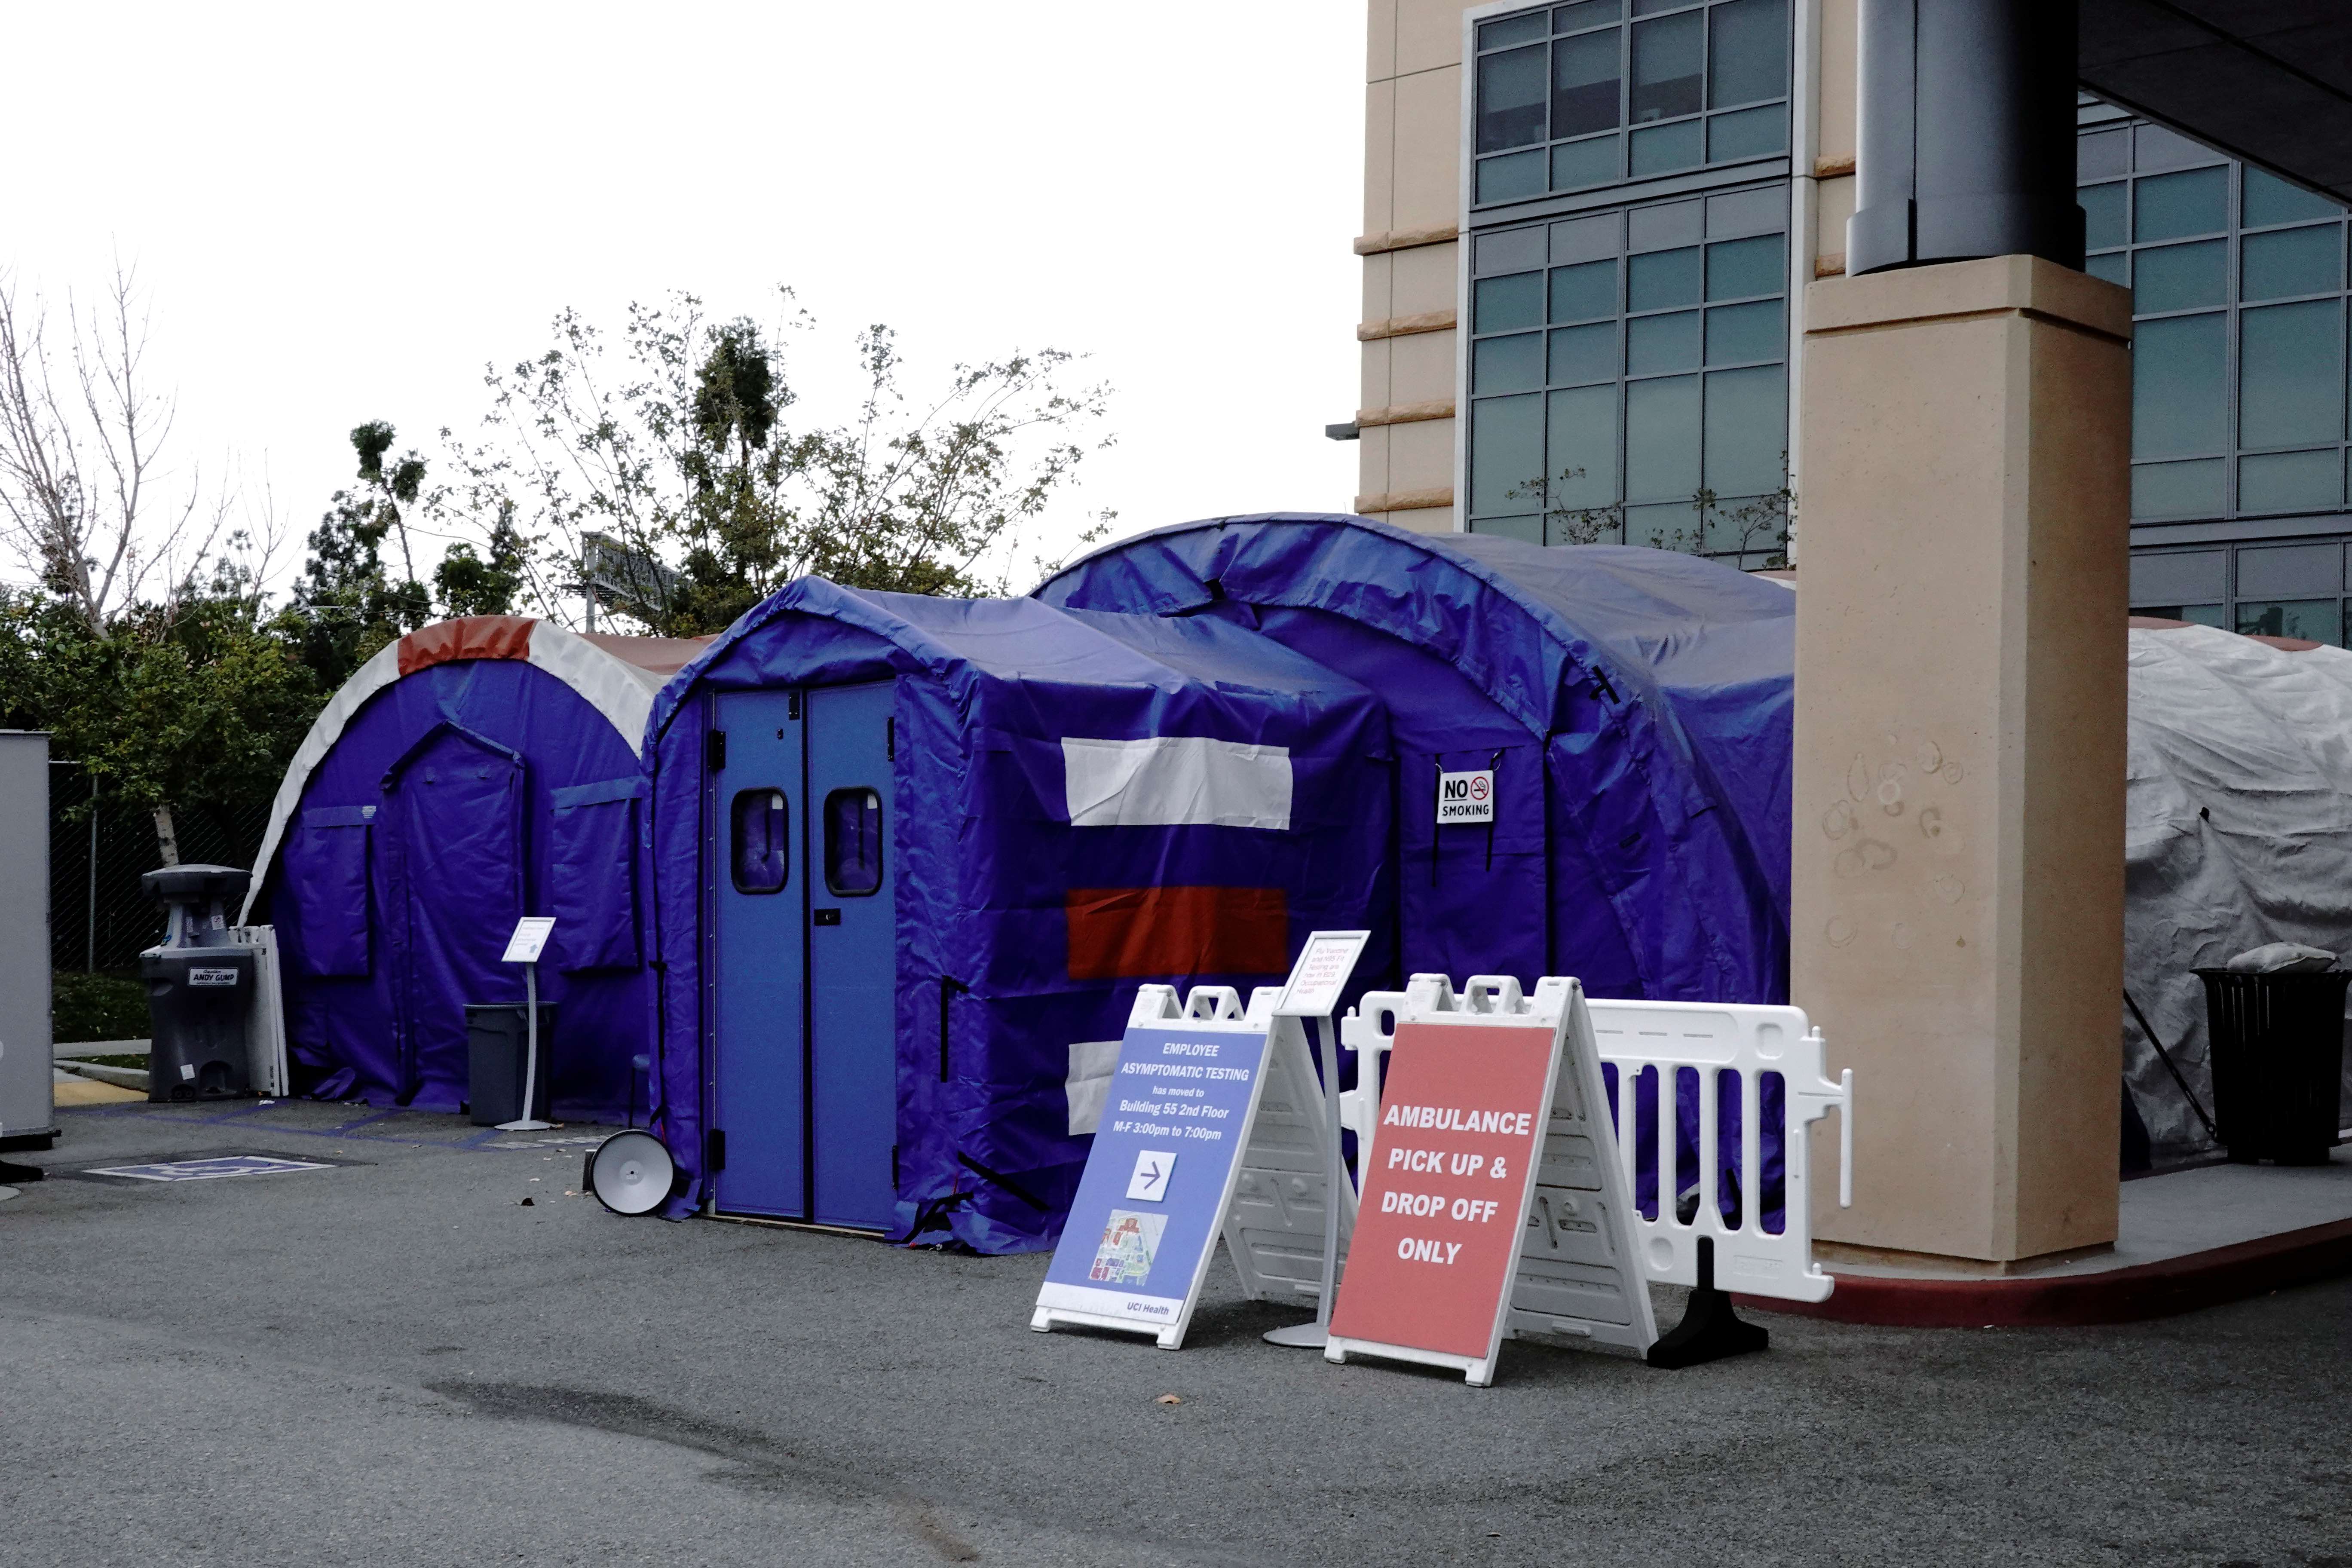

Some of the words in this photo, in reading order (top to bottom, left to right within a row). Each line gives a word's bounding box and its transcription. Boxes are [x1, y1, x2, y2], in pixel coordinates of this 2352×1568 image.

[1445, 779, 1468, 798] NO
[1442, 804, 1489, 816] SMOKING
[1163, 1043, 1219, 1057] EMPLOYEE
[1121, 1063, 1204, 1078] ASYMPTOMATIC
[1206, 1067, 1249, 1081] TESTING
[1152, 1086, 1166, 1095] has
[1168, 1087, 1194, 1096] moved
[1120, 1099, 1162, 1115] Building
[1163, 1103, 1177, 1115] 55
[1179, 1104, 1199, 1116] 2nd
[1201, 1106, 1229, 1118] Floor
[1383, 1105, 1531, 1135] AMBULANCE
[1113, 1121, 1132, 1132] M-F
[1133, 1122, 1170, 1136] 3:00pm
[1172, 1126, 1182, 1136] to
[1185, 1126, 1222, 1141] 7:00pm
[1388, 1148, 1445, 1173] PICK
[1451, 1154, 1484, 1176] UP
[1490, 1157, 1507, 1178] &
[1381, 1191, 1446, 1217] DROP
[1451, 1198, 1498, 1223] OFF
[1398, 1237, 1463, 1265] ONLY
[1127, 1302, 1142, 1311] UCI
[1143, 1304, 1169, 1315] Health
